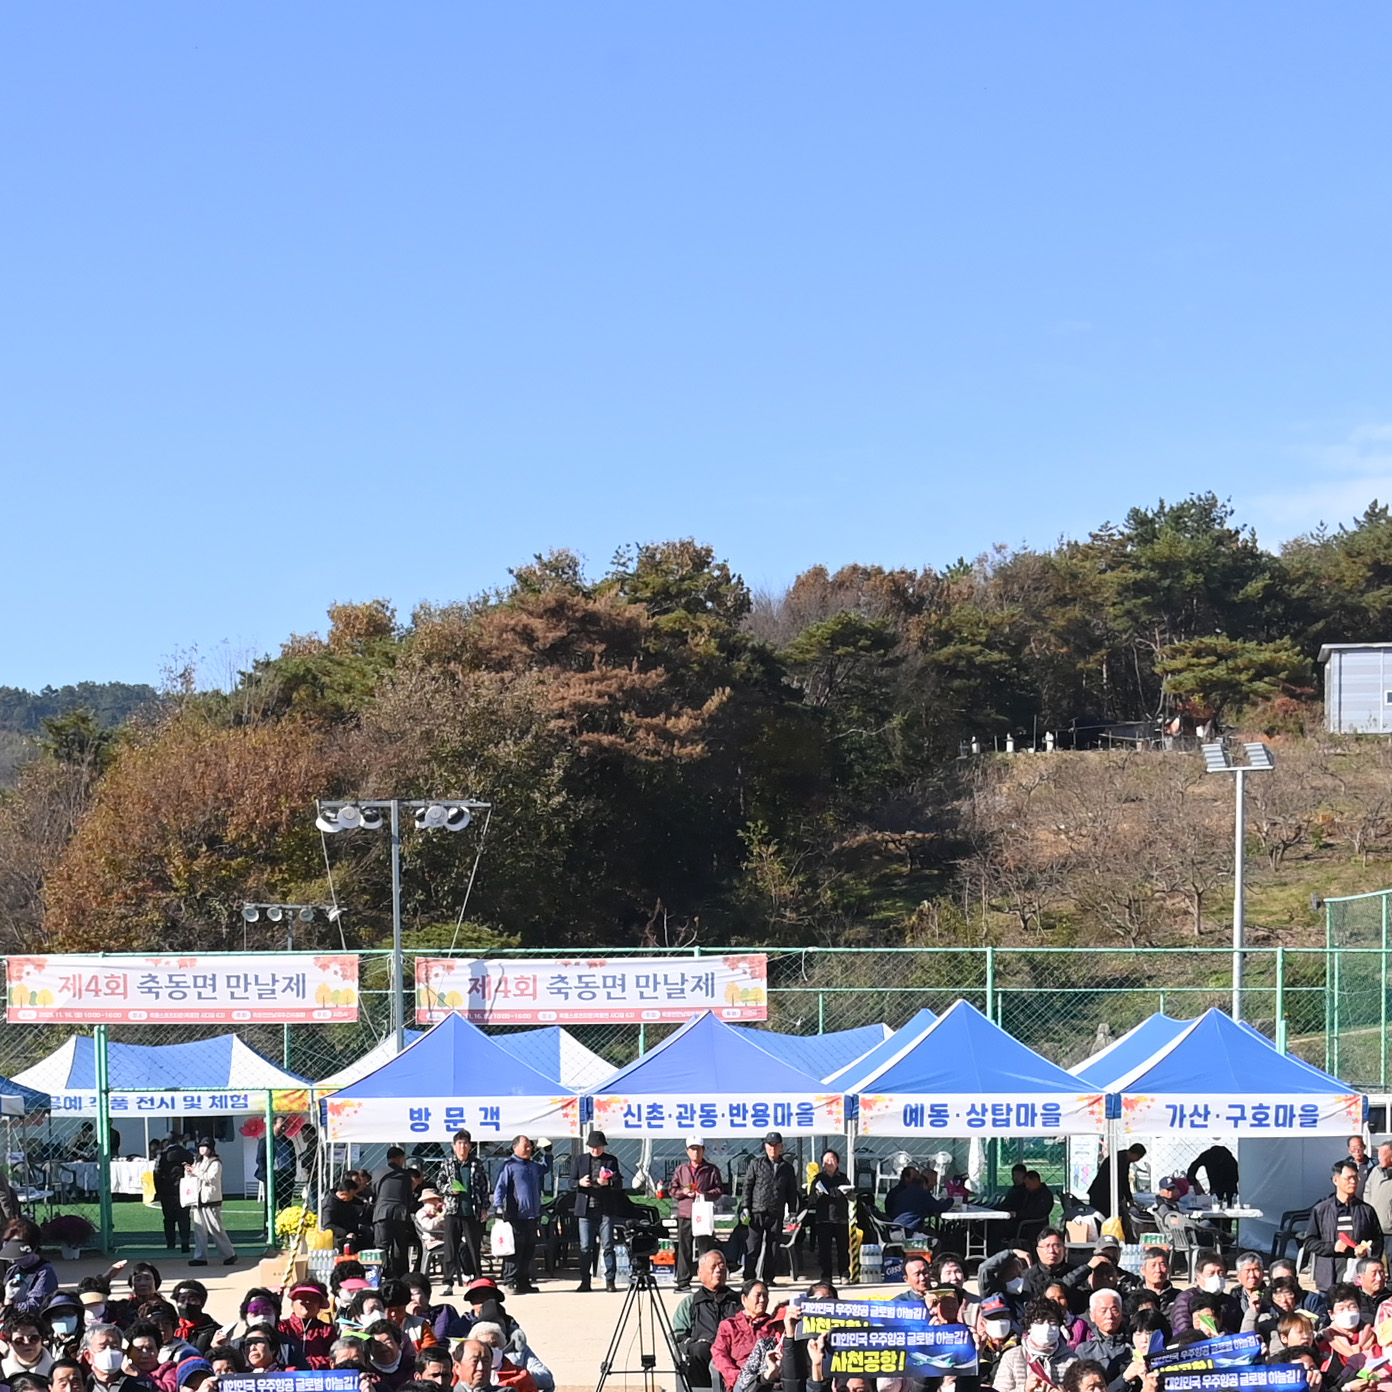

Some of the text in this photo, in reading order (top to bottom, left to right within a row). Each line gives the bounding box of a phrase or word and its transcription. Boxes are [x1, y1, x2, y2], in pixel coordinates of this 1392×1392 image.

[59, 973, 306, 1000] 제4회 축동면 만날제
[468, 972, 716, 1001] 제4회 축동면 만날제
[831, 1329, 967, 1346] 대한민국 우주항공 글로벌 하늘길!
[831, 1350, 905, 1373] 사천공항!
[257, 1379, 293, 1392] 우주항공
[295, 1378, 322, 1392] 글로벌
[324, 1377, 357, 1392] 하늘길!
[1165, 1368, 1302, 1391] 대한민국 우주항공 글로벌 하늘길!
